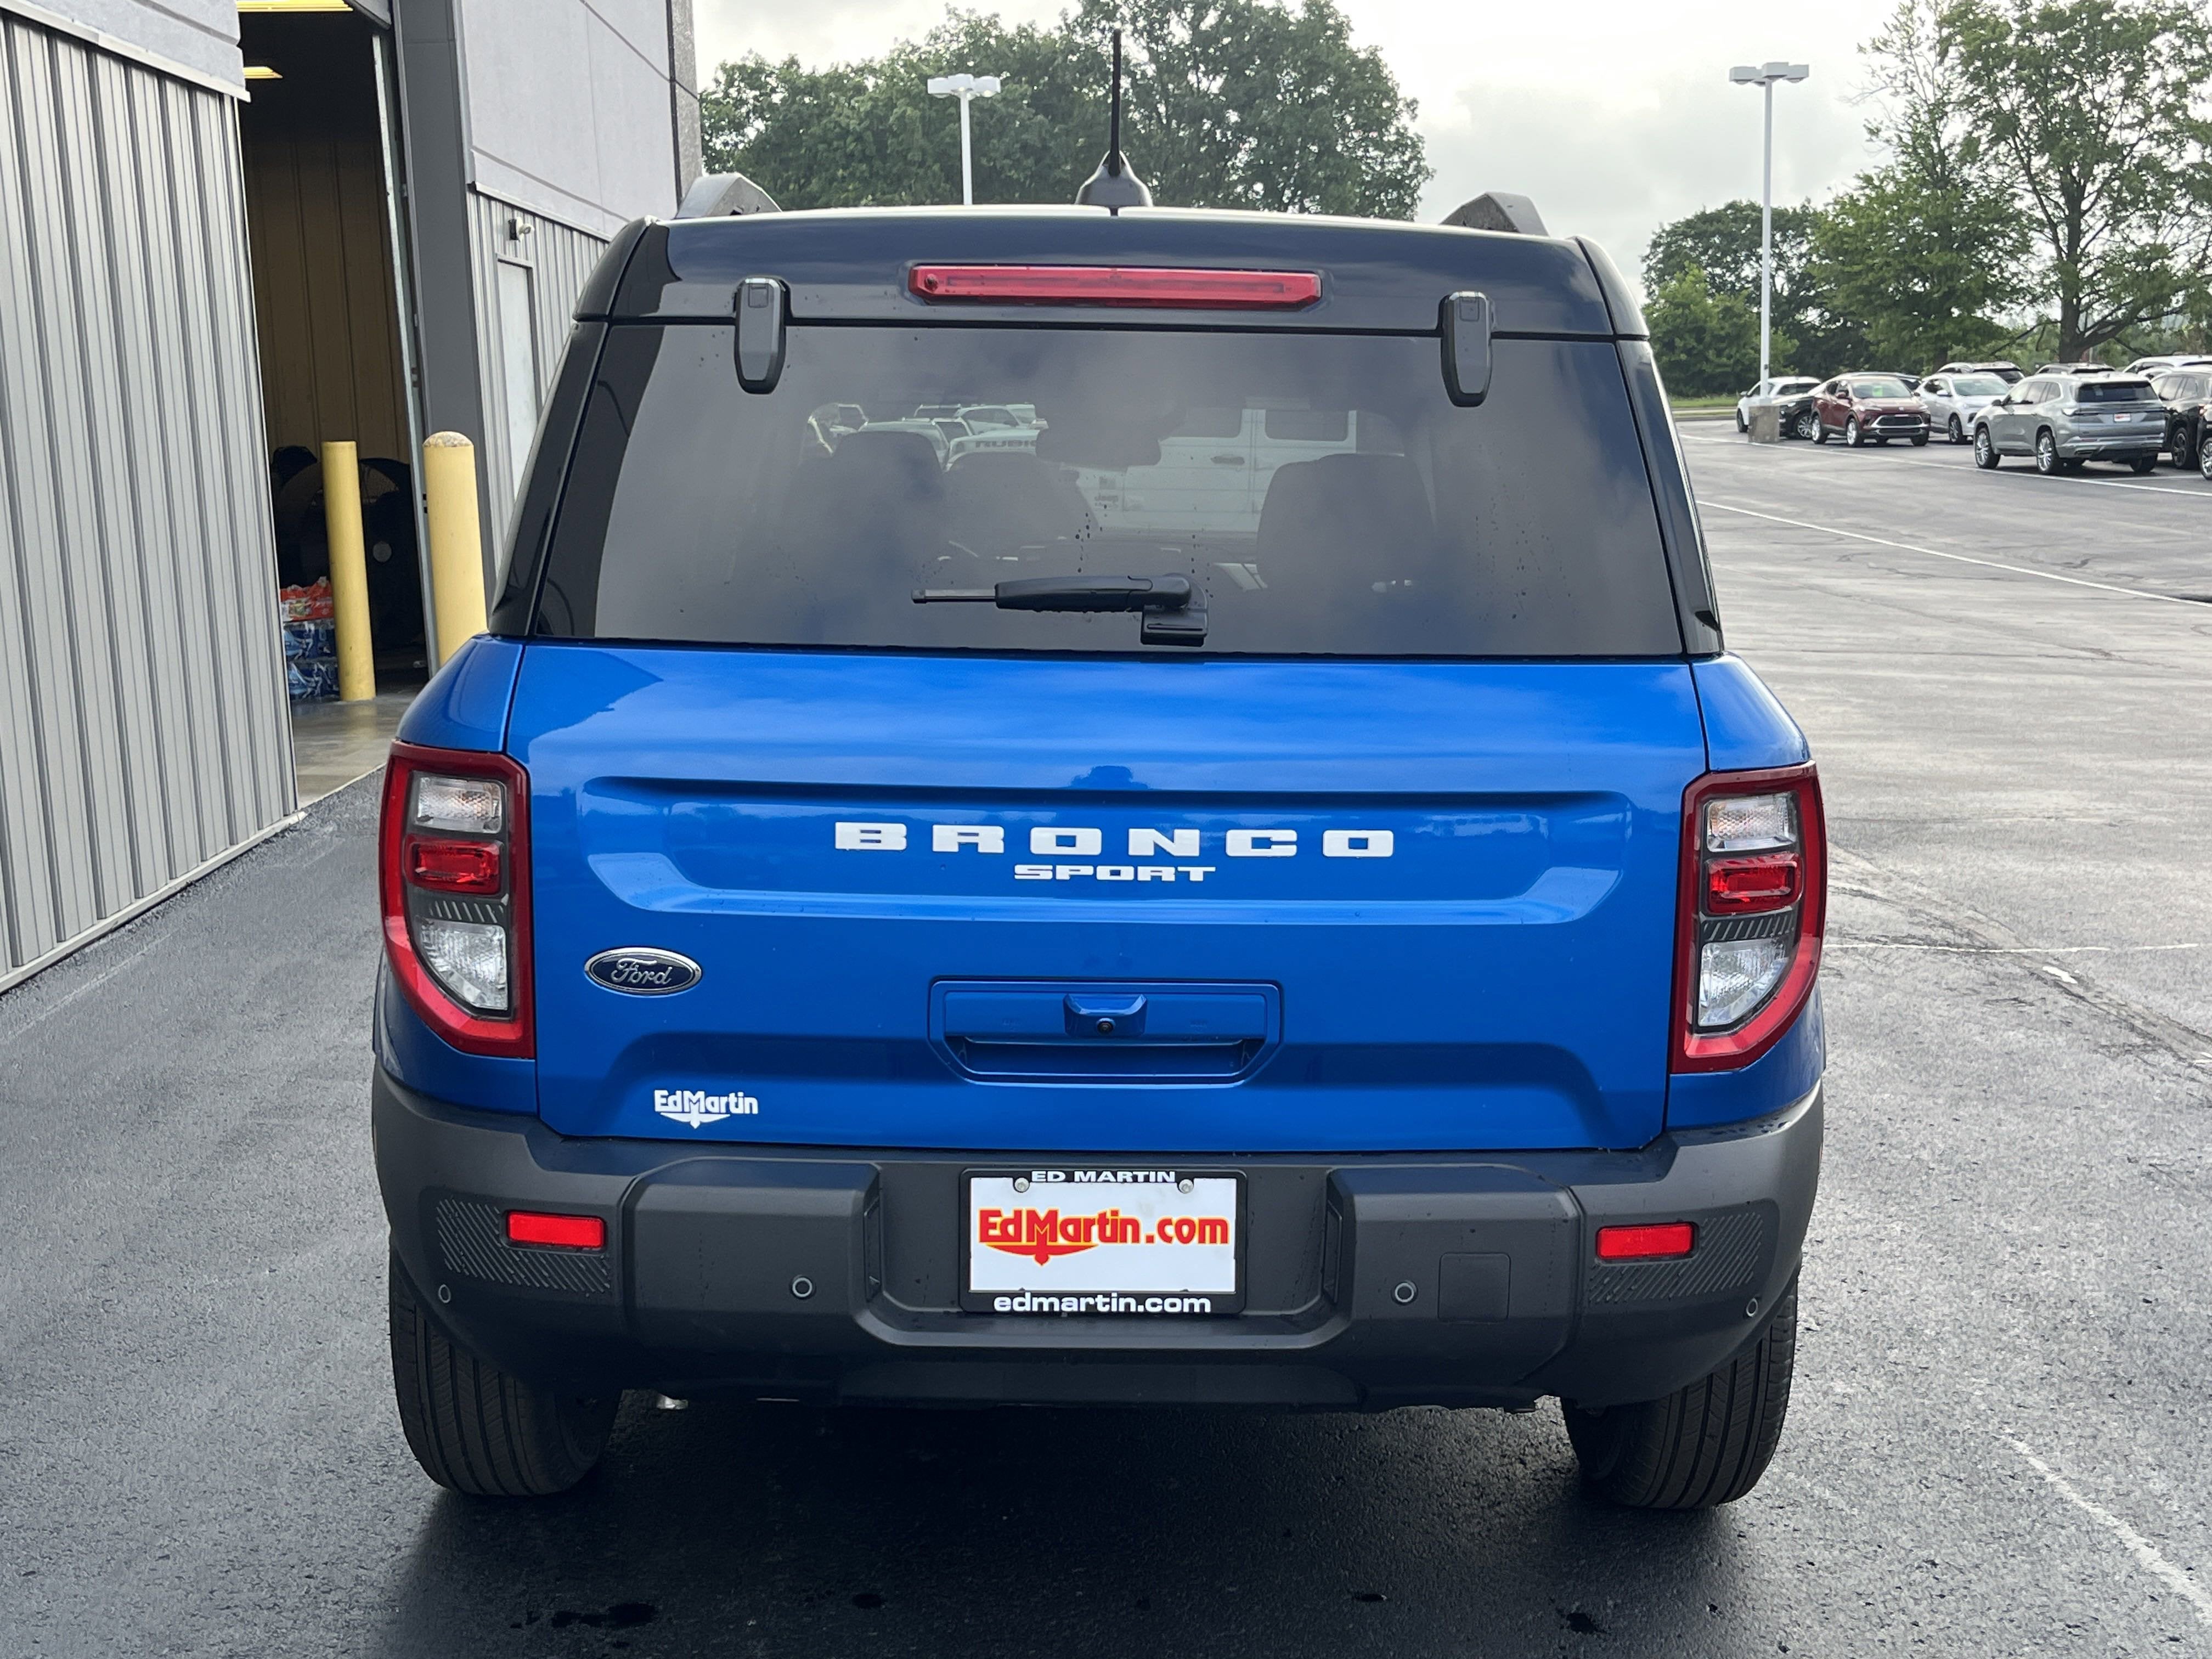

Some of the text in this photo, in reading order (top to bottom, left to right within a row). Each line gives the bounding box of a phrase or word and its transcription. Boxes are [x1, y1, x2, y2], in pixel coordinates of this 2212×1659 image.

[835, 822, 1393, 857] BRONCO
[1014, 865, 1216, 881] SPORT
[611, 958, 673, 984] Ford
[654, 1090, 758, 1115] EdMartin
[1031, 1170, 1176, 1183] ED MARTIN
[978, 1208, 1229, 1245] EdMartin.com
[994, 1293, 1211, 1313] edmartin.com
